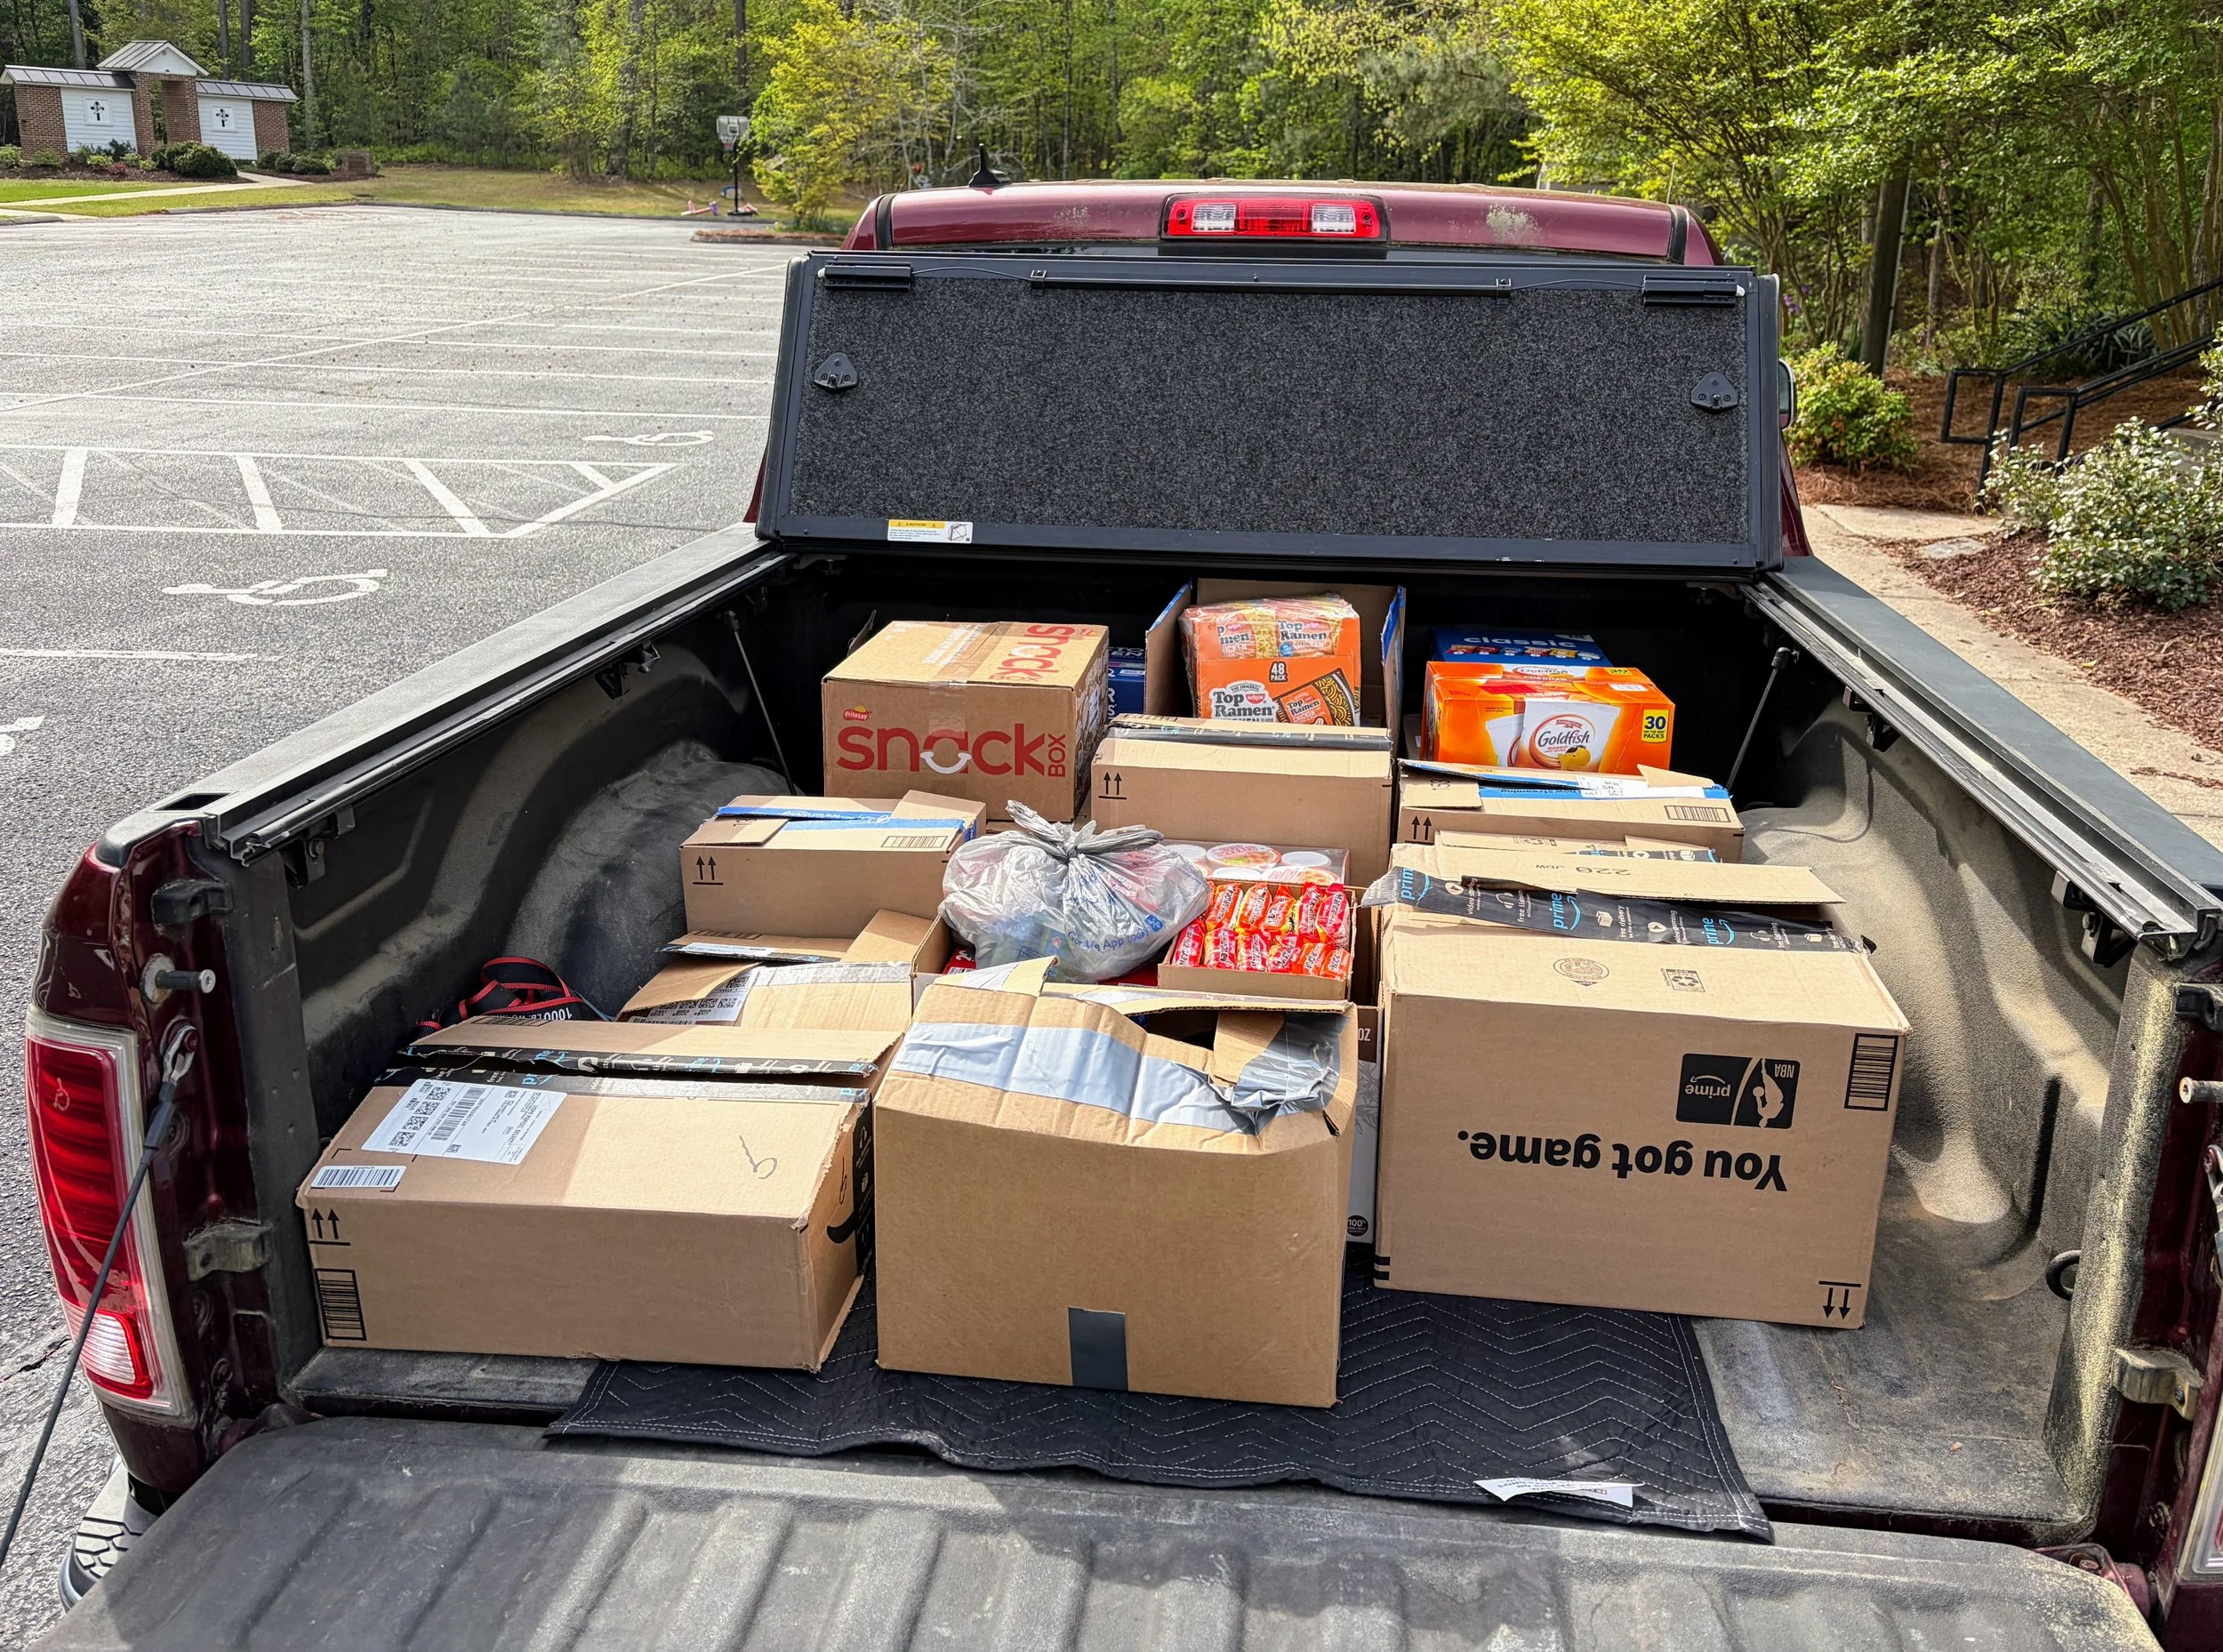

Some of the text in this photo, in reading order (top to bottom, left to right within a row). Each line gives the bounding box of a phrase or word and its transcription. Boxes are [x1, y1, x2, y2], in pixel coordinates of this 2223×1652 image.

[1278, 621, 1304, 632] Top
[1219, 632, 1249, 645] men
[1280, 630, 1327, 641] Ramen
[1464, 636, 1577, 648] classic
[996, 624, 1076, 678] snack
[1271, 662, 1285, 675] 48
[1213, 691, 1244, 707] Top
[1287, 699, 1304, 710] Top
[1215, 704, 1273, 717] Ramen
[1290, 701, 1320, 716] Ramen
[1644, 716, 1666, 730] 30
[1537, 729, 1591, 748] Goldfish
[836, 723, 1045, 776] snack
[1047, 733, 1067, 778] BOX
[1575, 866, 1632, 876] 220
[1400, 867, 1415, 900] prim
[1467, 895, 1475, 915] video
[1551, 893, 1568, 930] prime
[1517, 909, 1525, 923] free
[1617, 904, 1625, 926] delivery
[1103, 938, 1124, 950] App
[1774, 1063, 1795, 1079] NBA
[1684, 1084, 1731, 1099] prime
[1457, 1129, 1788, 1192] You got game.
